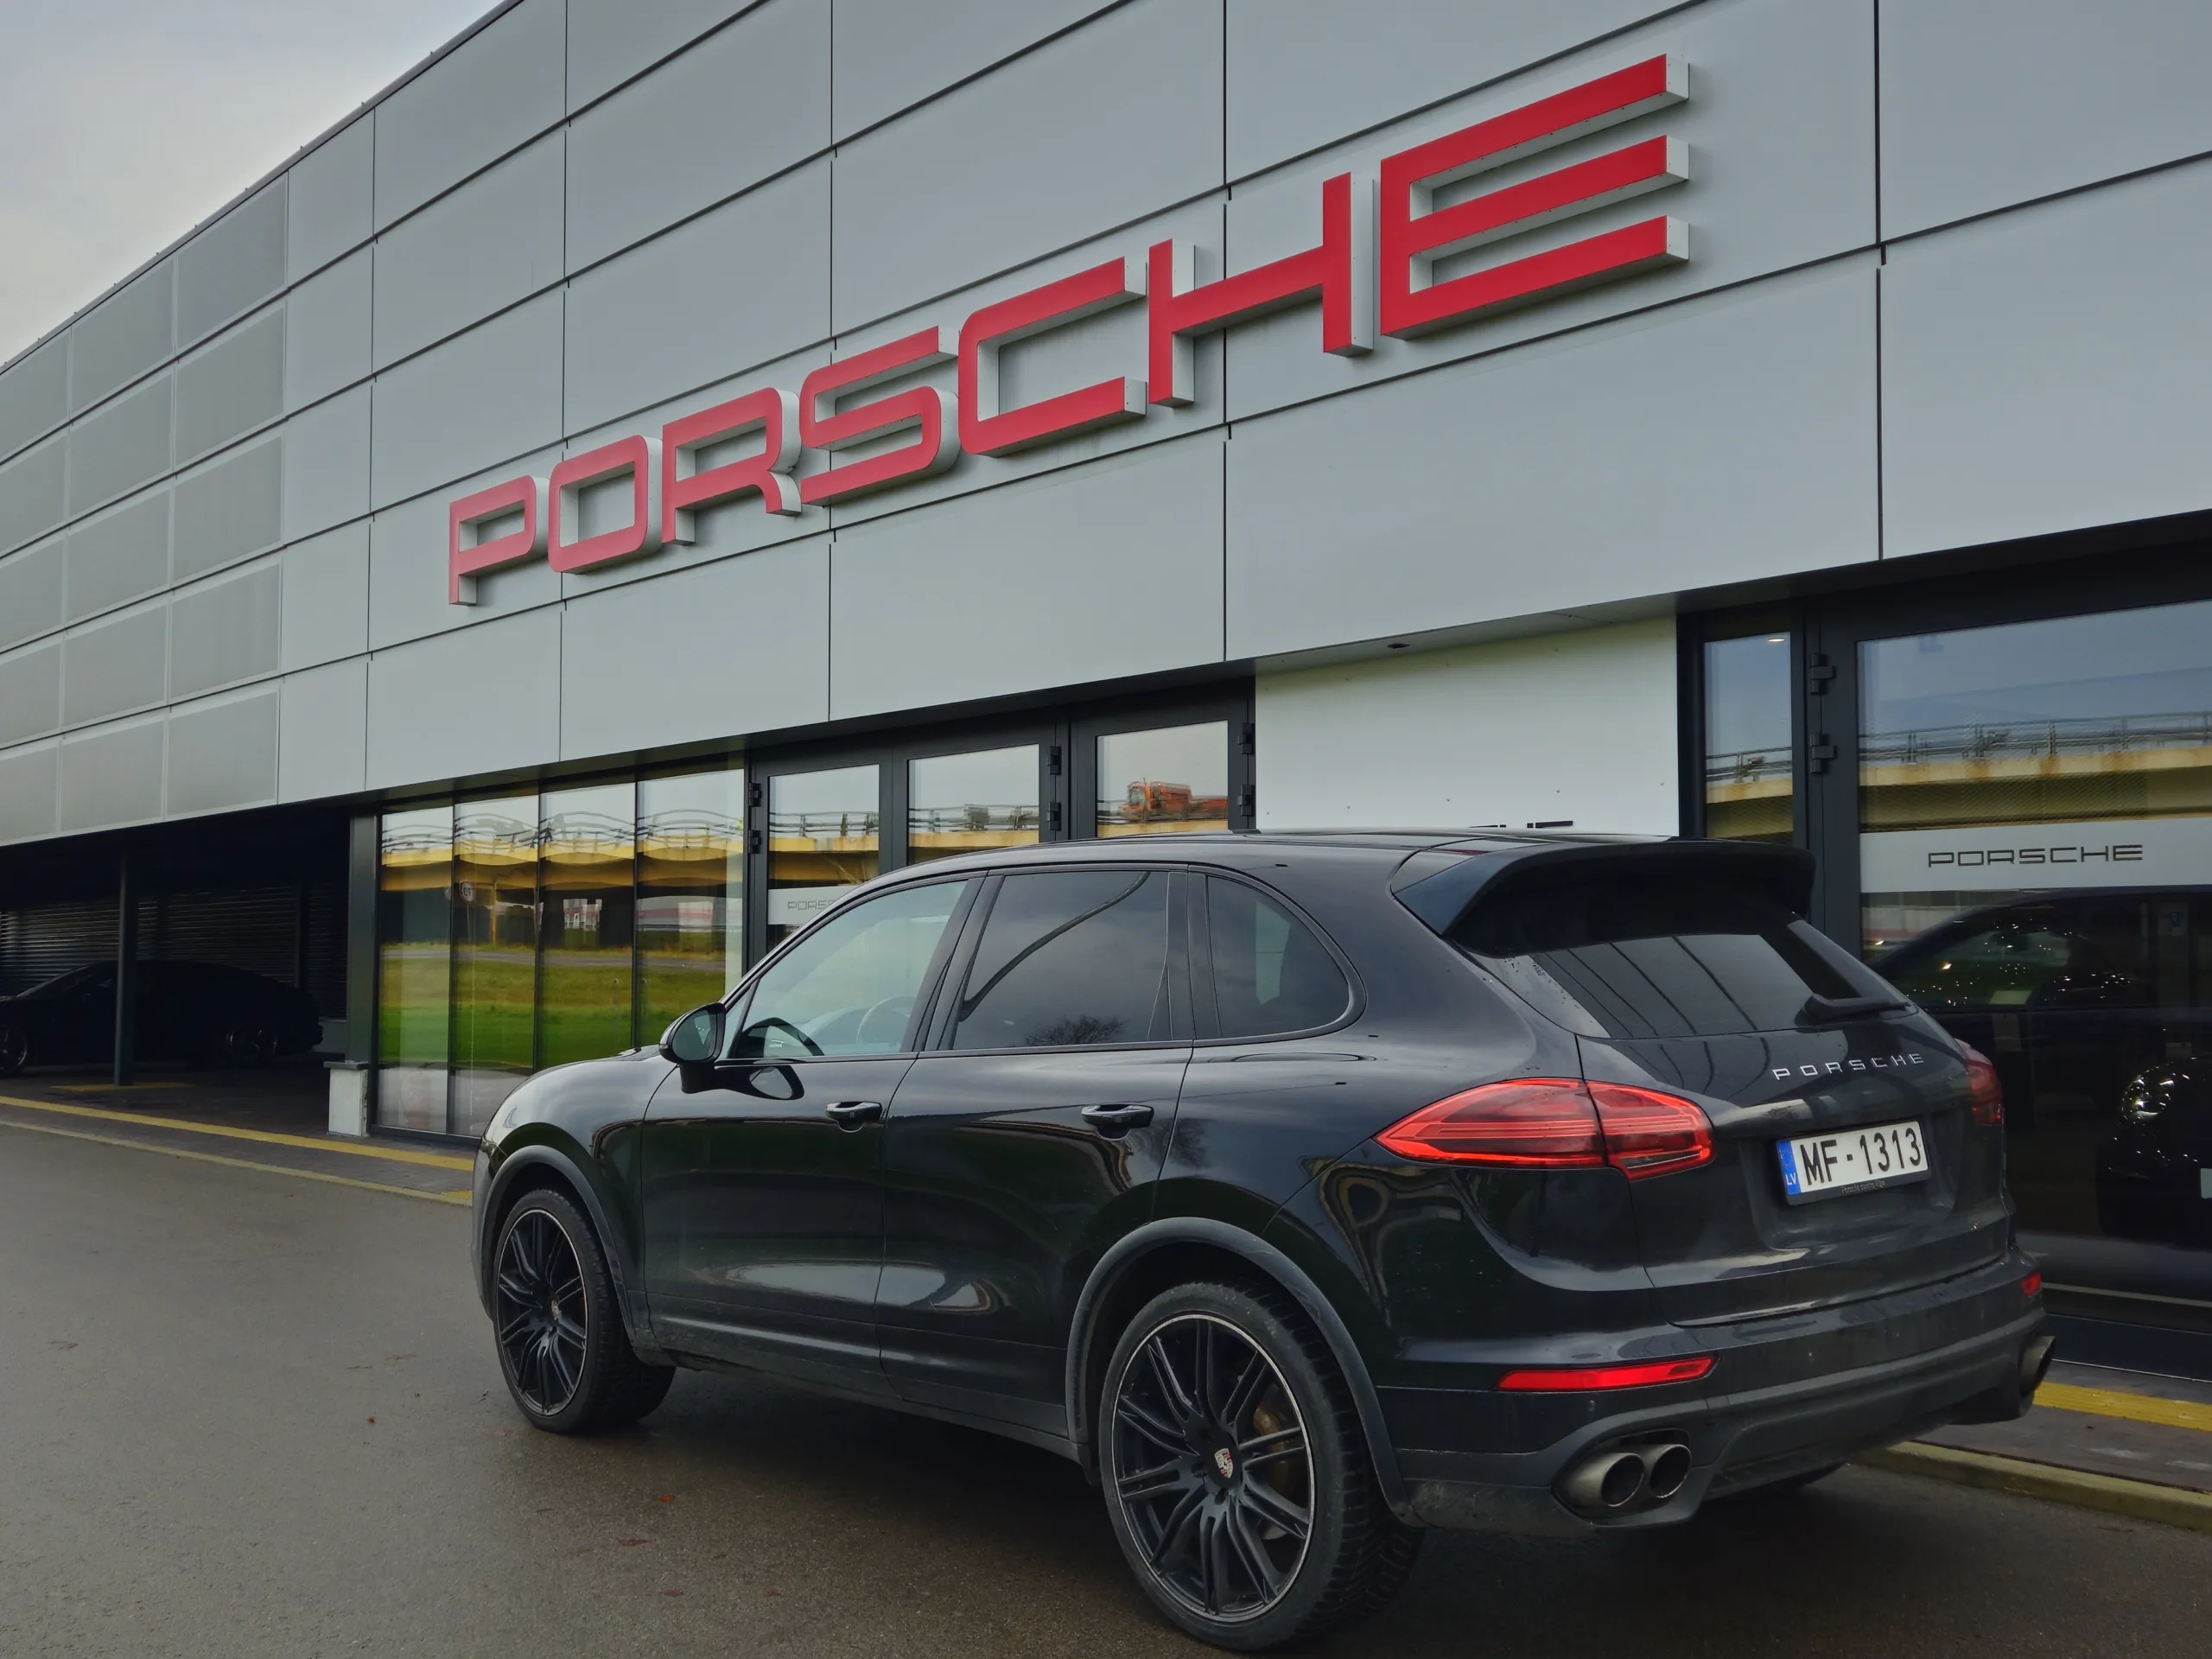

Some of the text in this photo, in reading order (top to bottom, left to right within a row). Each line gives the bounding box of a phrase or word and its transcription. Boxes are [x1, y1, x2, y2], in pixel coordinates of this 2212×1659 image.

[448, 54, 1689, 605] PORSCHE
[1928, 844, 2143, 868] PORSCHE
[787, 899, 836, 911] PORS
[1771, 1053, 1925, 1080] PORSCHE
[1799, 1127, 1922, 1186] MF-1313
[1785, 1173, 1796, 1186] LV
